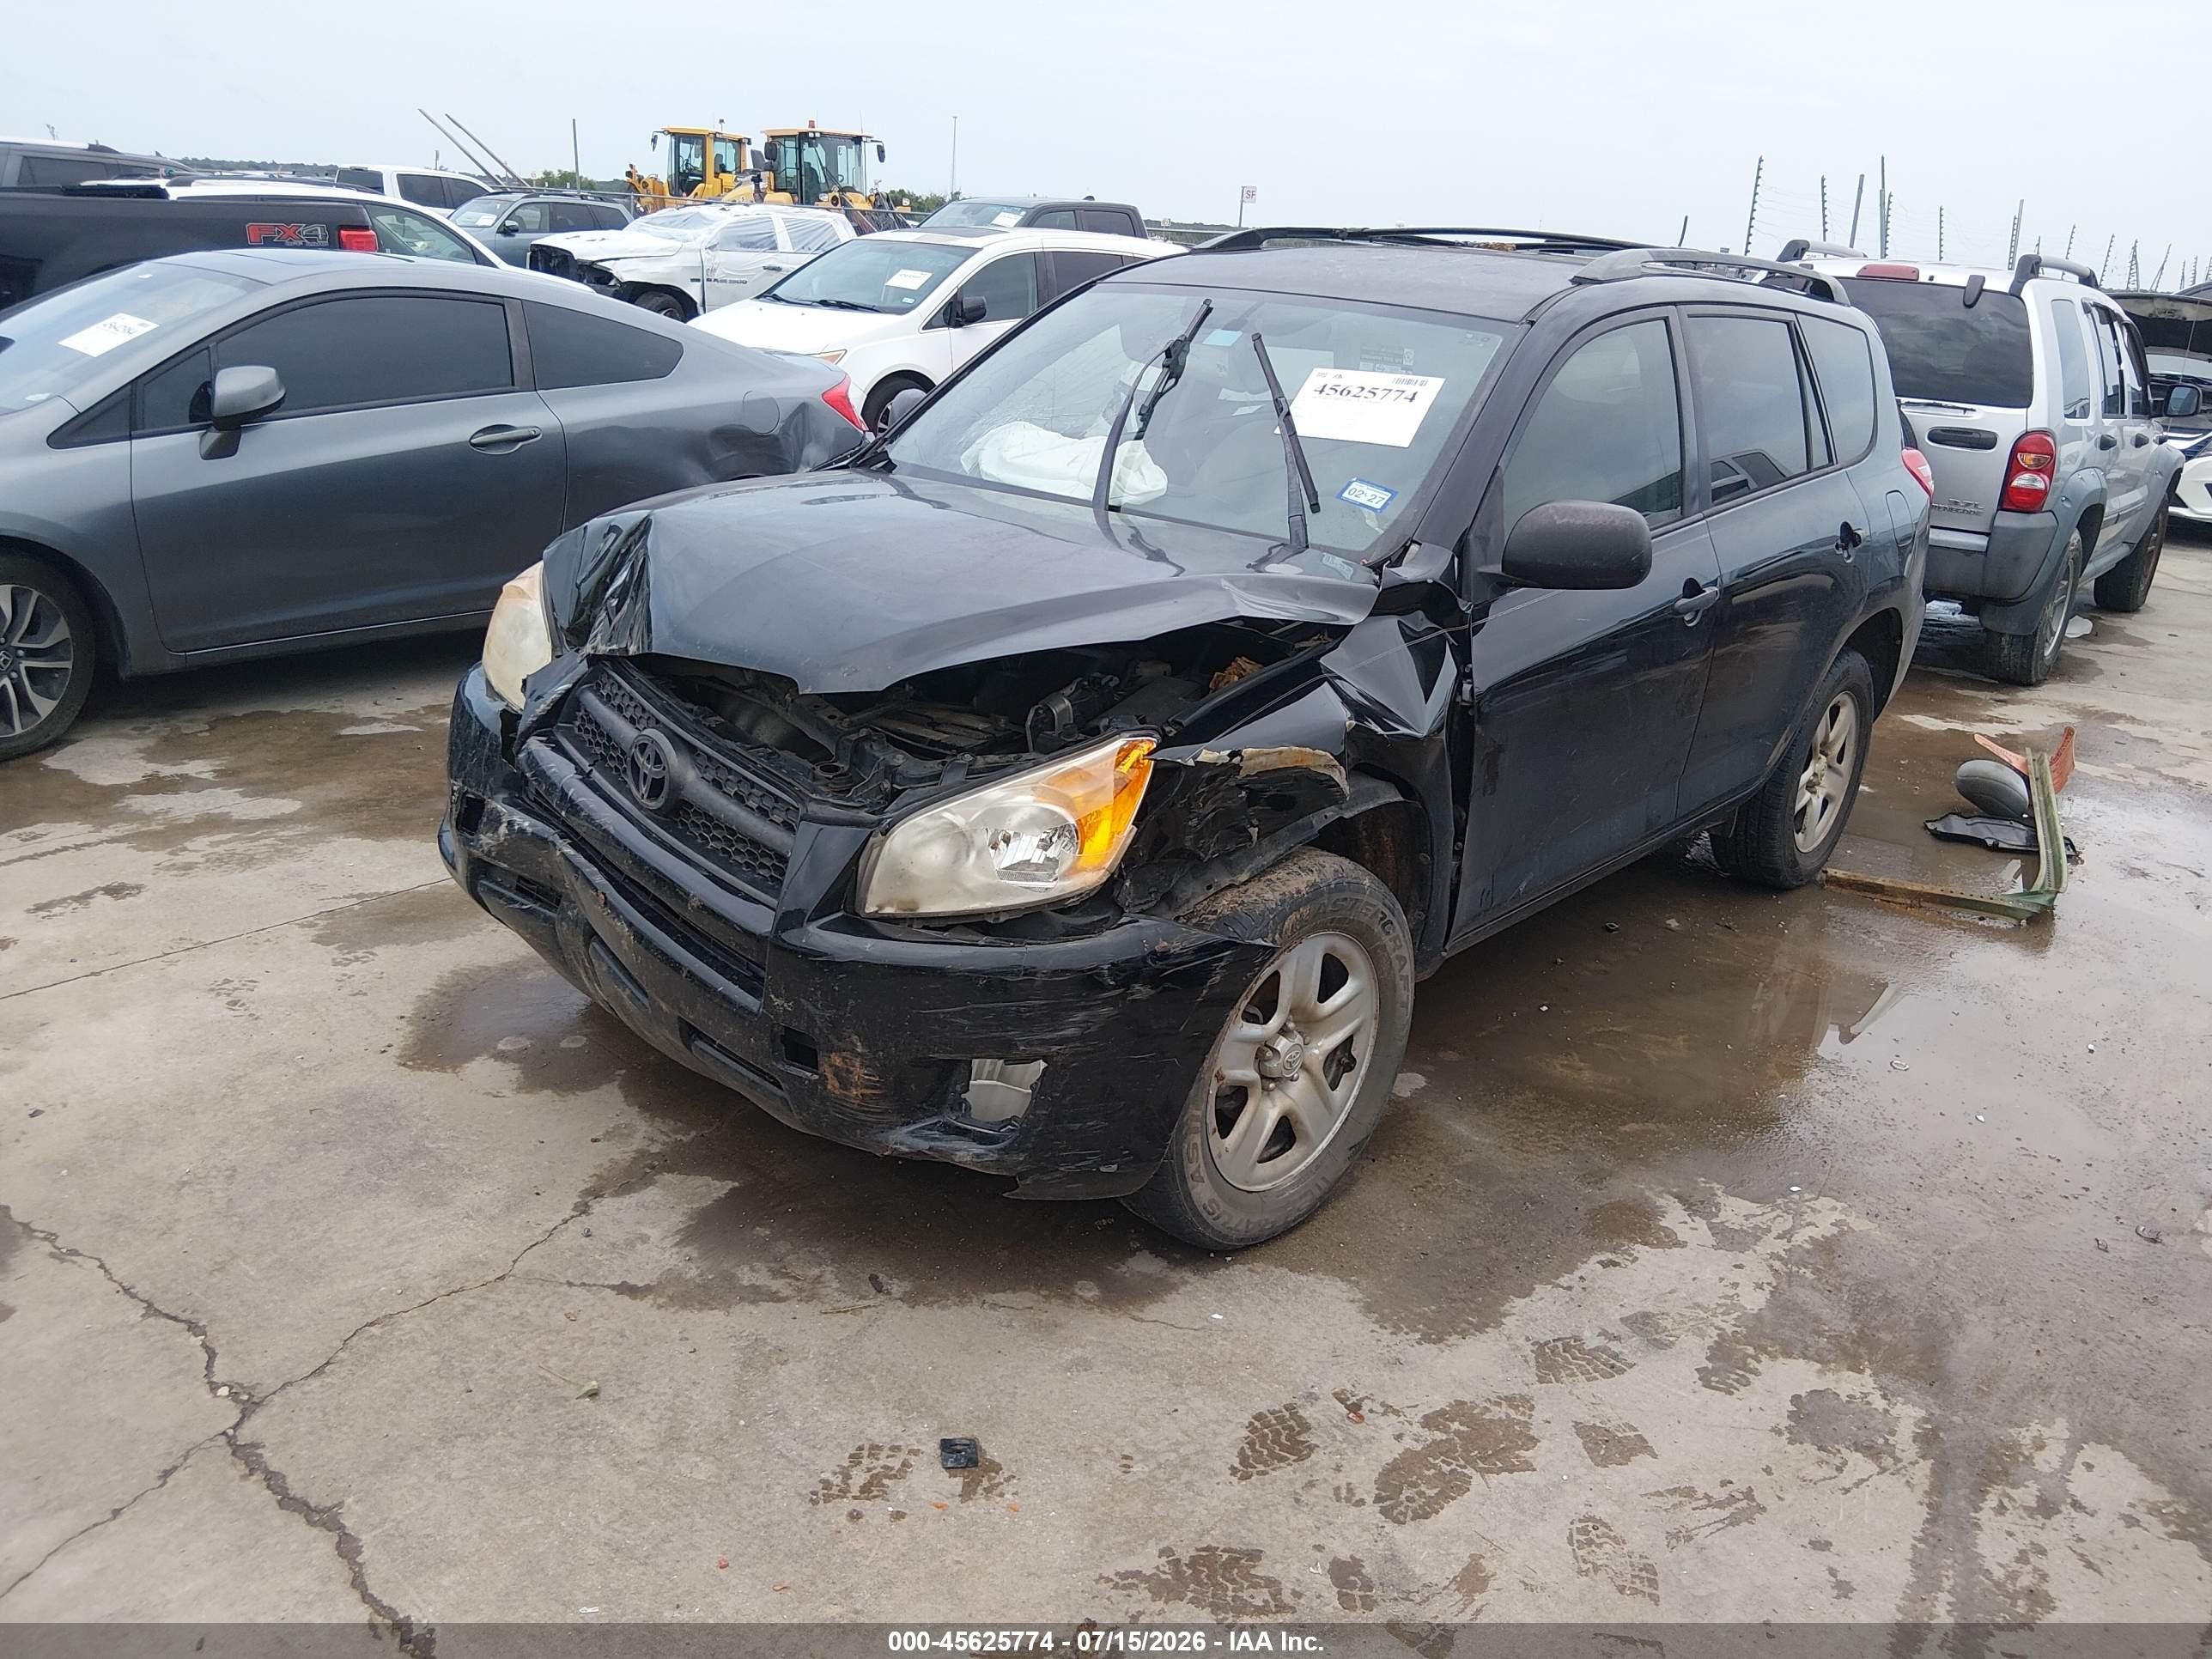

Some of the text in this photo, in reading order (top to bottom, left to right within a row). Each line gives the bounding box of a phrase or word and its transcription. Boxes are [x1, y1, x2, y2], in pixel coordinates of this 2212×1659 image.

[1245, 189, 1256, 199] SF
[246, 223, 329, 245] FX4
[1313, 383, 1419, 404] 45625774
[1298, 896, 1411, 1018] ASTERCRAFT
